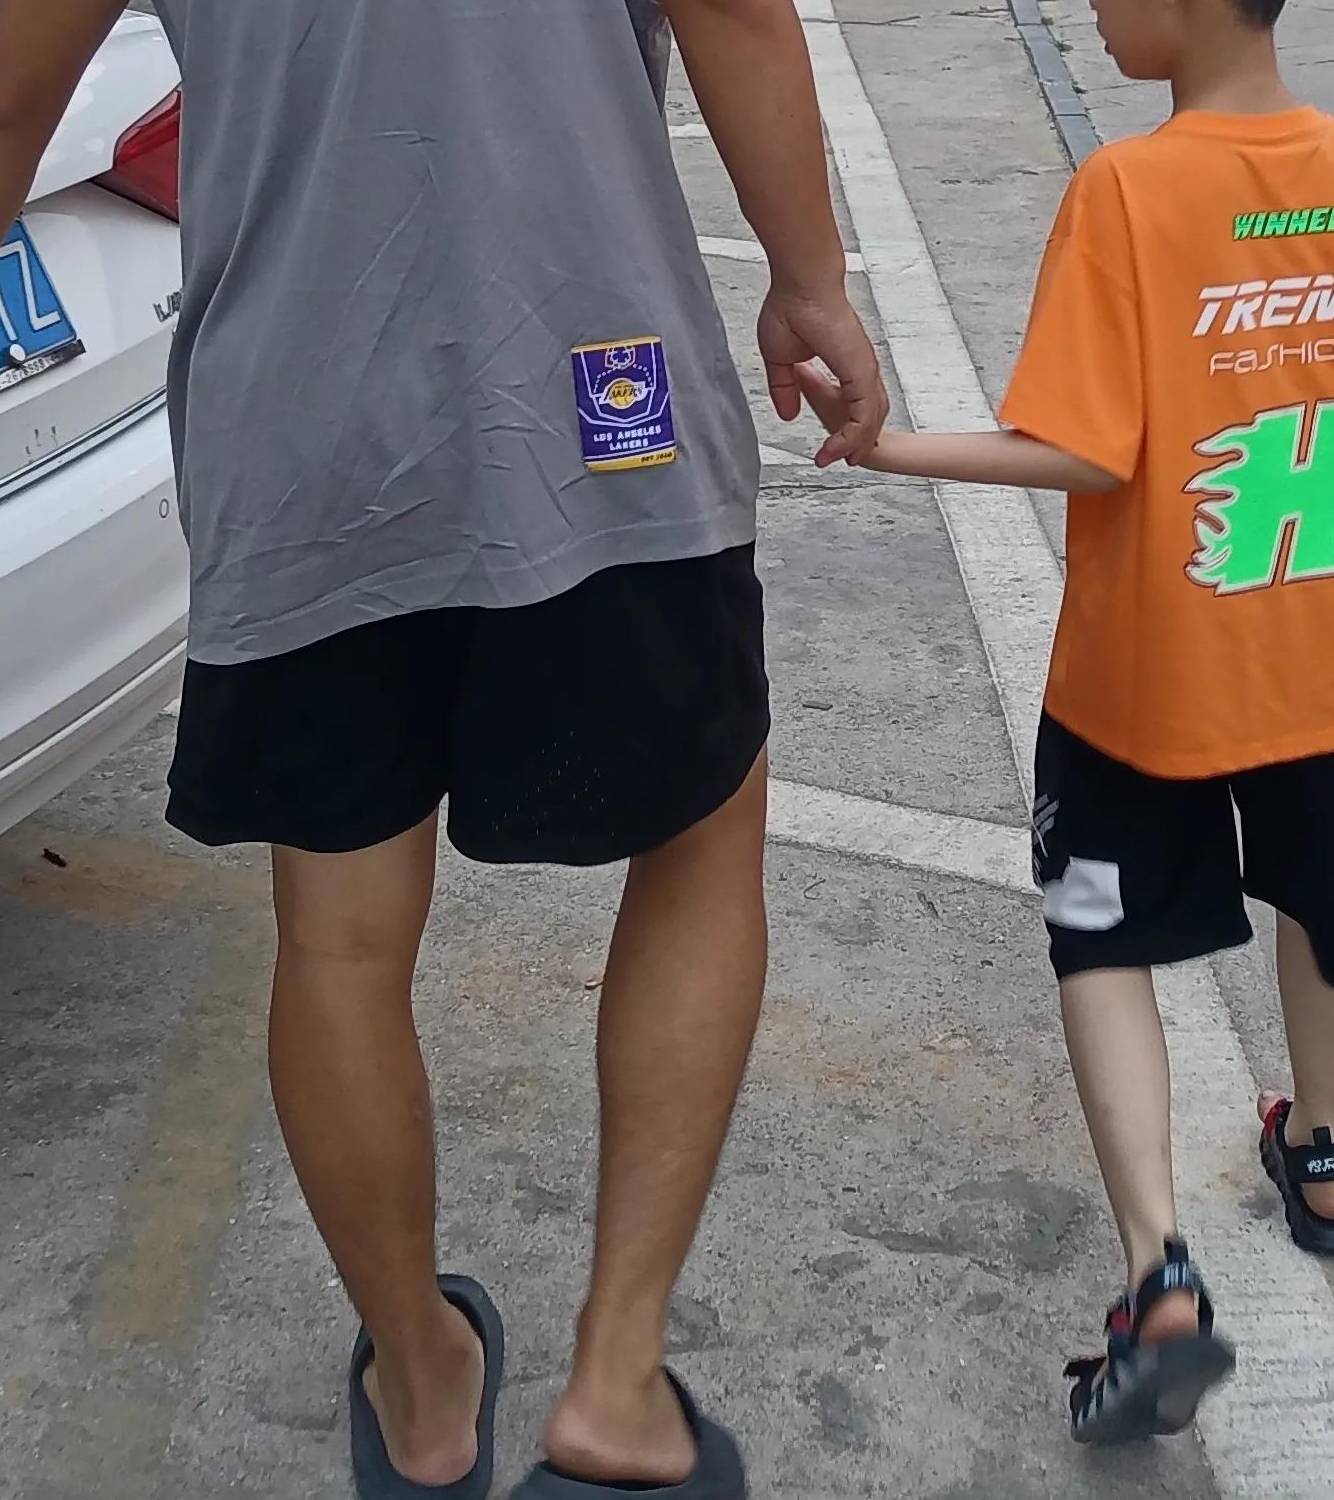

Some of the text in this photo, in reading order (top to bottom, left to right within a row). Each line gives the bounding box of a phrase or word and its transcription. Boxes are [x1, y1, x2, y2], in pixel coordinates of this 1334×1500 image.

[593, 425, 662, 442] LOS ANGELES
[609, 438, 649, 450] LAKERS
